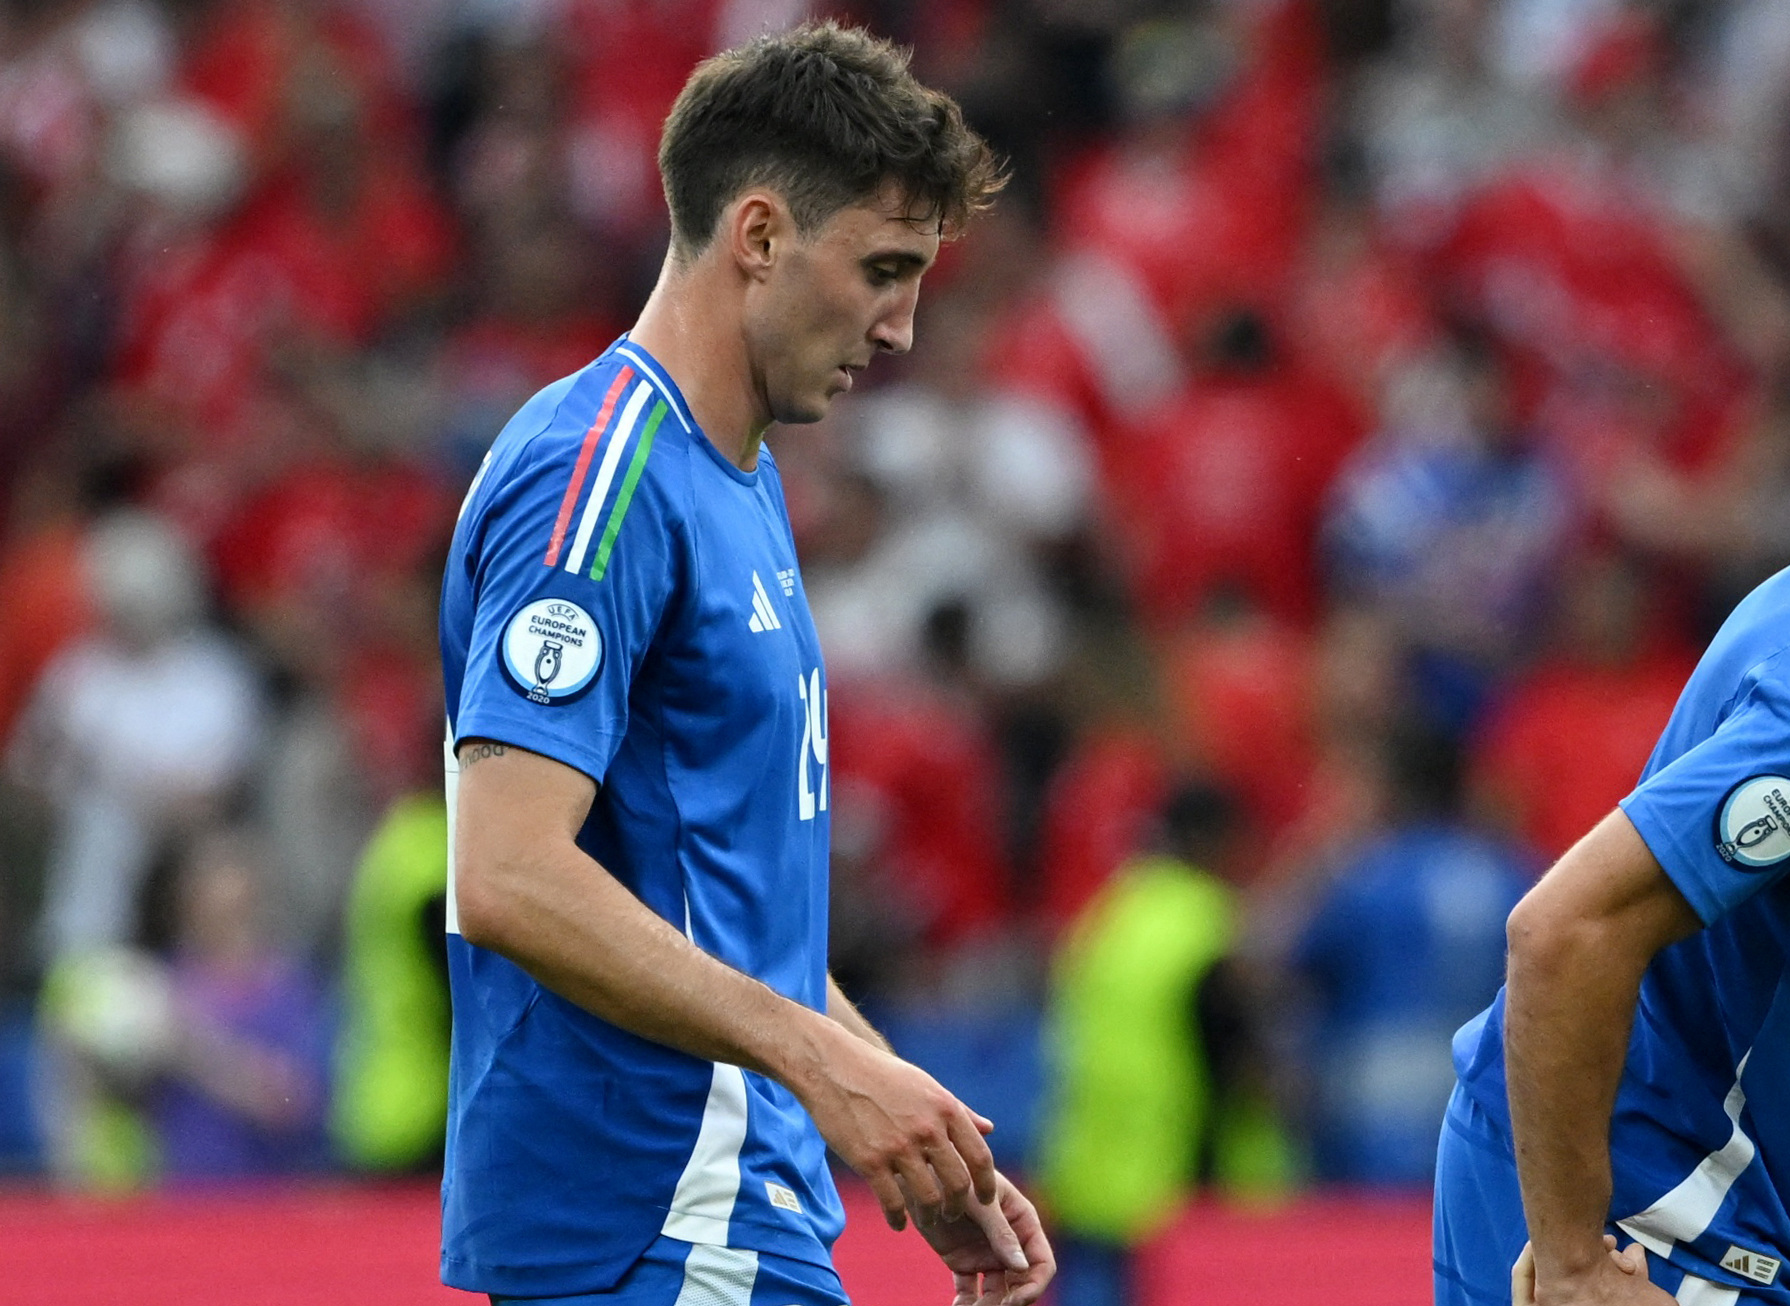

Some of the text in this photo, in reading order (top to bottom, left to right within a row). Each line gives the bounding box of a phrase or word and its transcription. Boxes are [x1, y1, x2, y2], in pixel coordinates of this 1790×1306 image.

[547, 606, 576, 621] UEFA
[531, 614, 587, 638] EUROPEAN
[528, 624, 583, 648] CHAMPIONS
[526, 691, 551, 705] 2020
[1715, 843, 1733, 862] 2020
